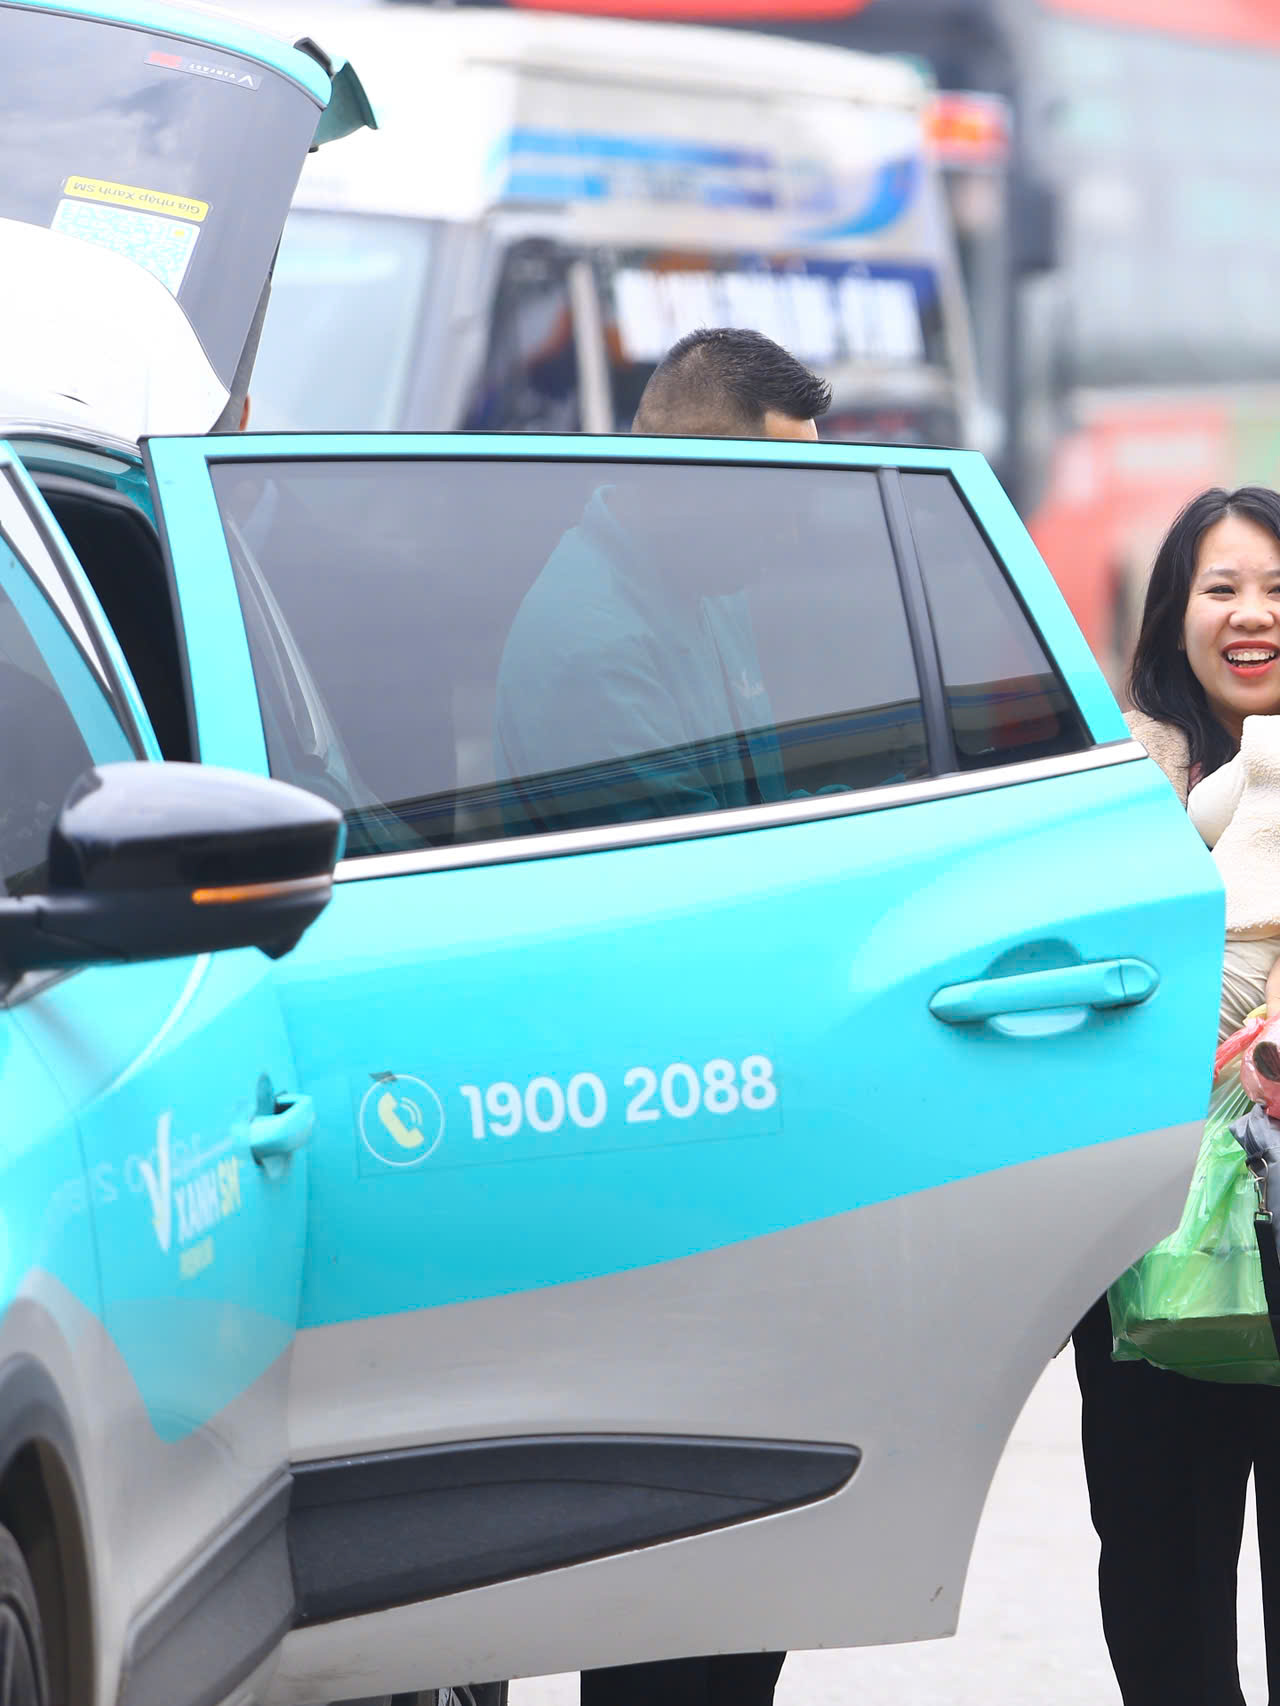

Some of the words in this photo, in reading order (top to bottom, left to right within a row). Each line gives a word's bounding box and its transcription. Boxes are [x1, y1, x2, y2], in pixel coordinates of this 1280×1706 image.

[73, 182, 97, 193] SM
[98, 186, 136, 201] Xanh
[178, 203, 200, 215] Gia
[459, 1072, 607, 1139] 1900
[623, 1055, 777, 1123] 2088
